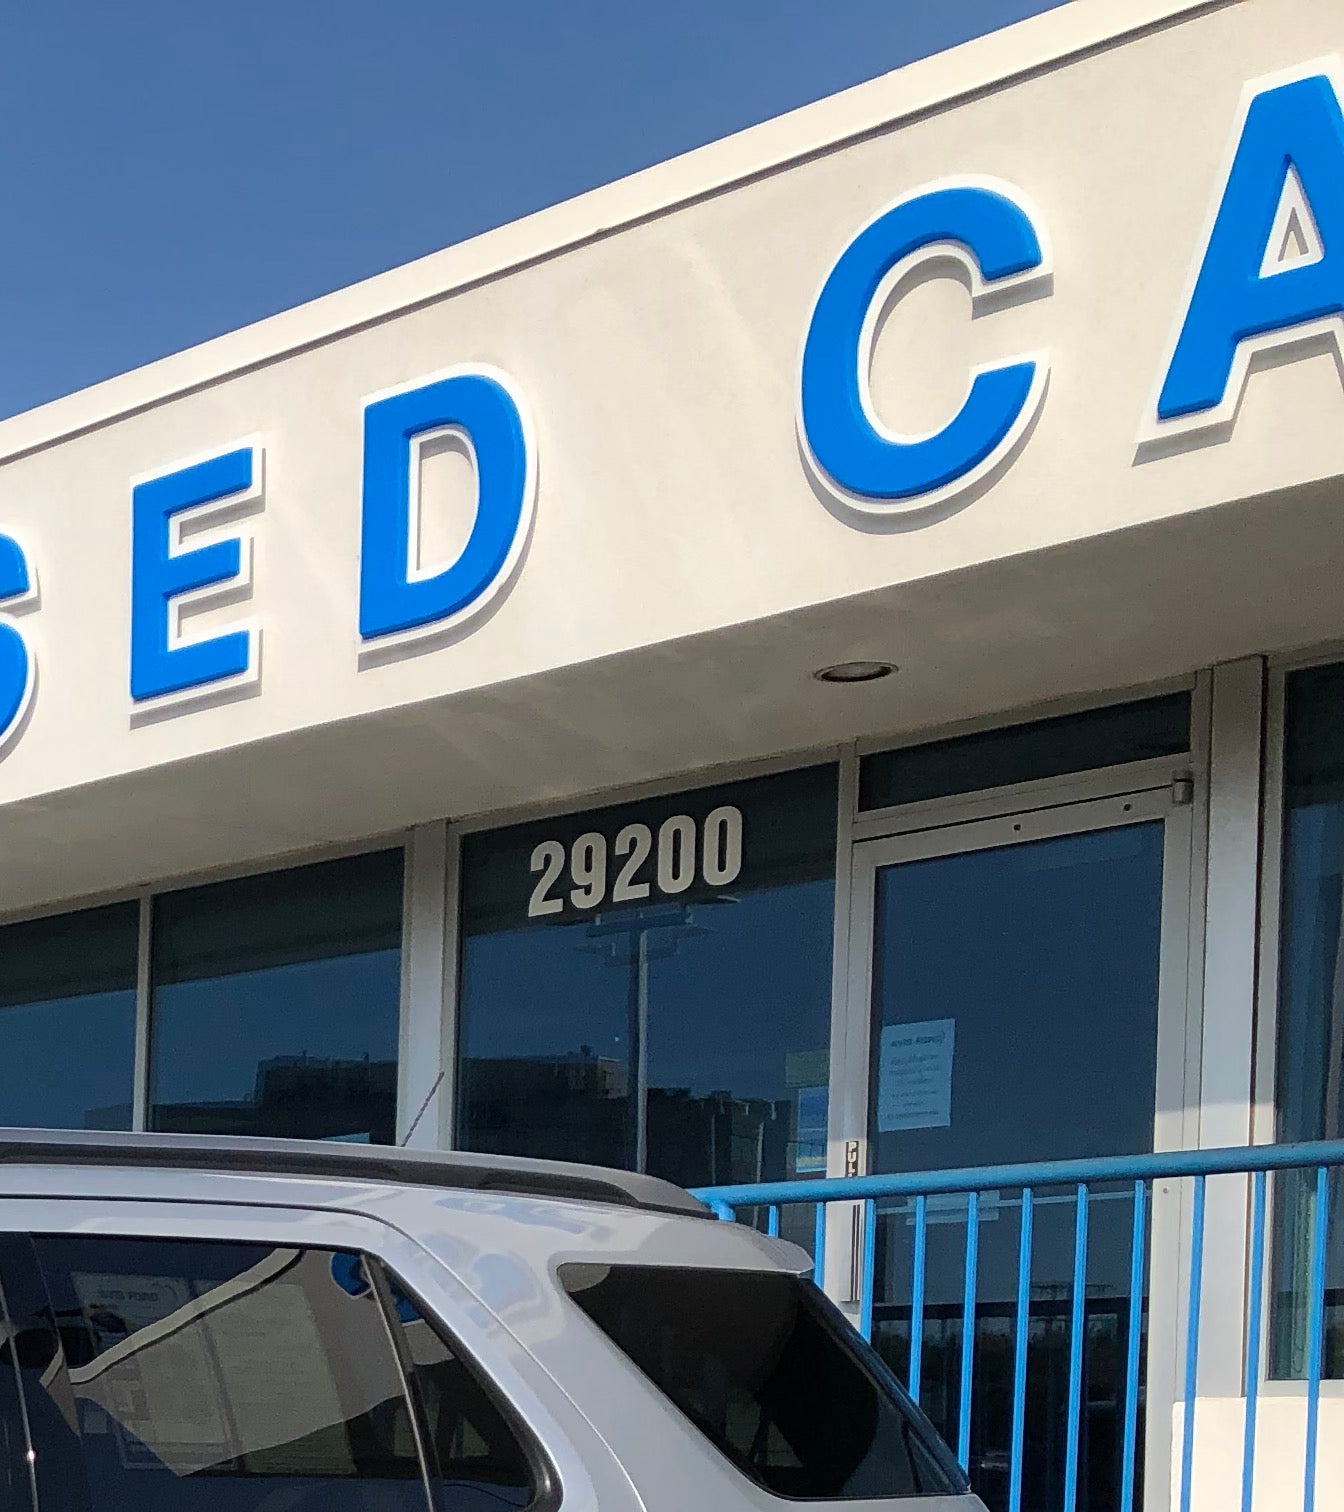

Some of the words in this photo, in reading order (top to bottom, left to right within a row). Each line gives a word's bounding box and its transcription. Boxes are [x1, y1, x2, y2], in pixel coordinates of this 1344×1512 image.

[796, 72, 1344, 510] CA
[527, 805, 744, 919] 29200
[847, 1141, 857, 1177] PUL
